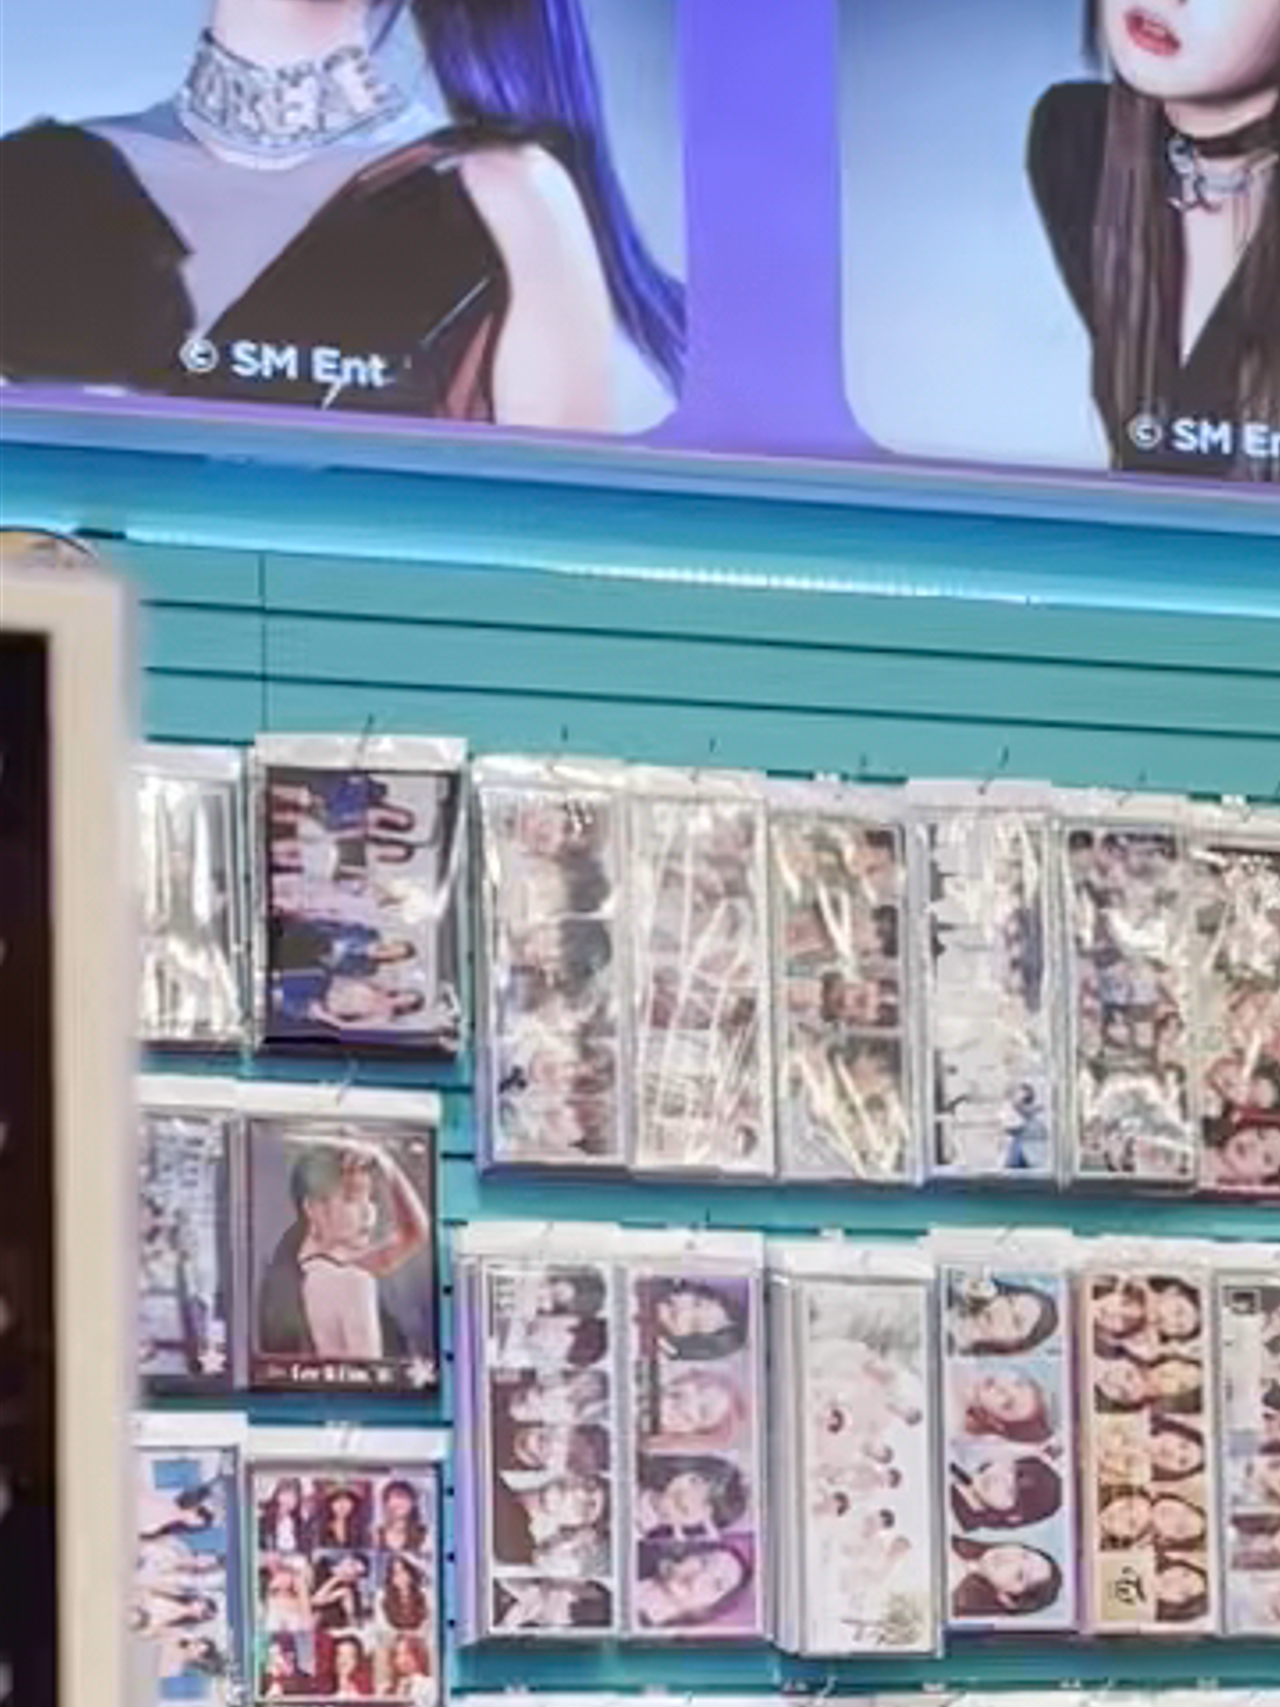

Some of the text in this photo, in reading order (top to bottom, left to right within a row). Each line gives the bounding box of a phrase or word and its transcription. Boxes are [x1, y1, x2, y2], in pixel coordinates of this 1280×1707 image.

[231, 342, 298, 378] SM
[311, 348, 389, 387] Ent
[1172, 419, 1232, 454] SM
